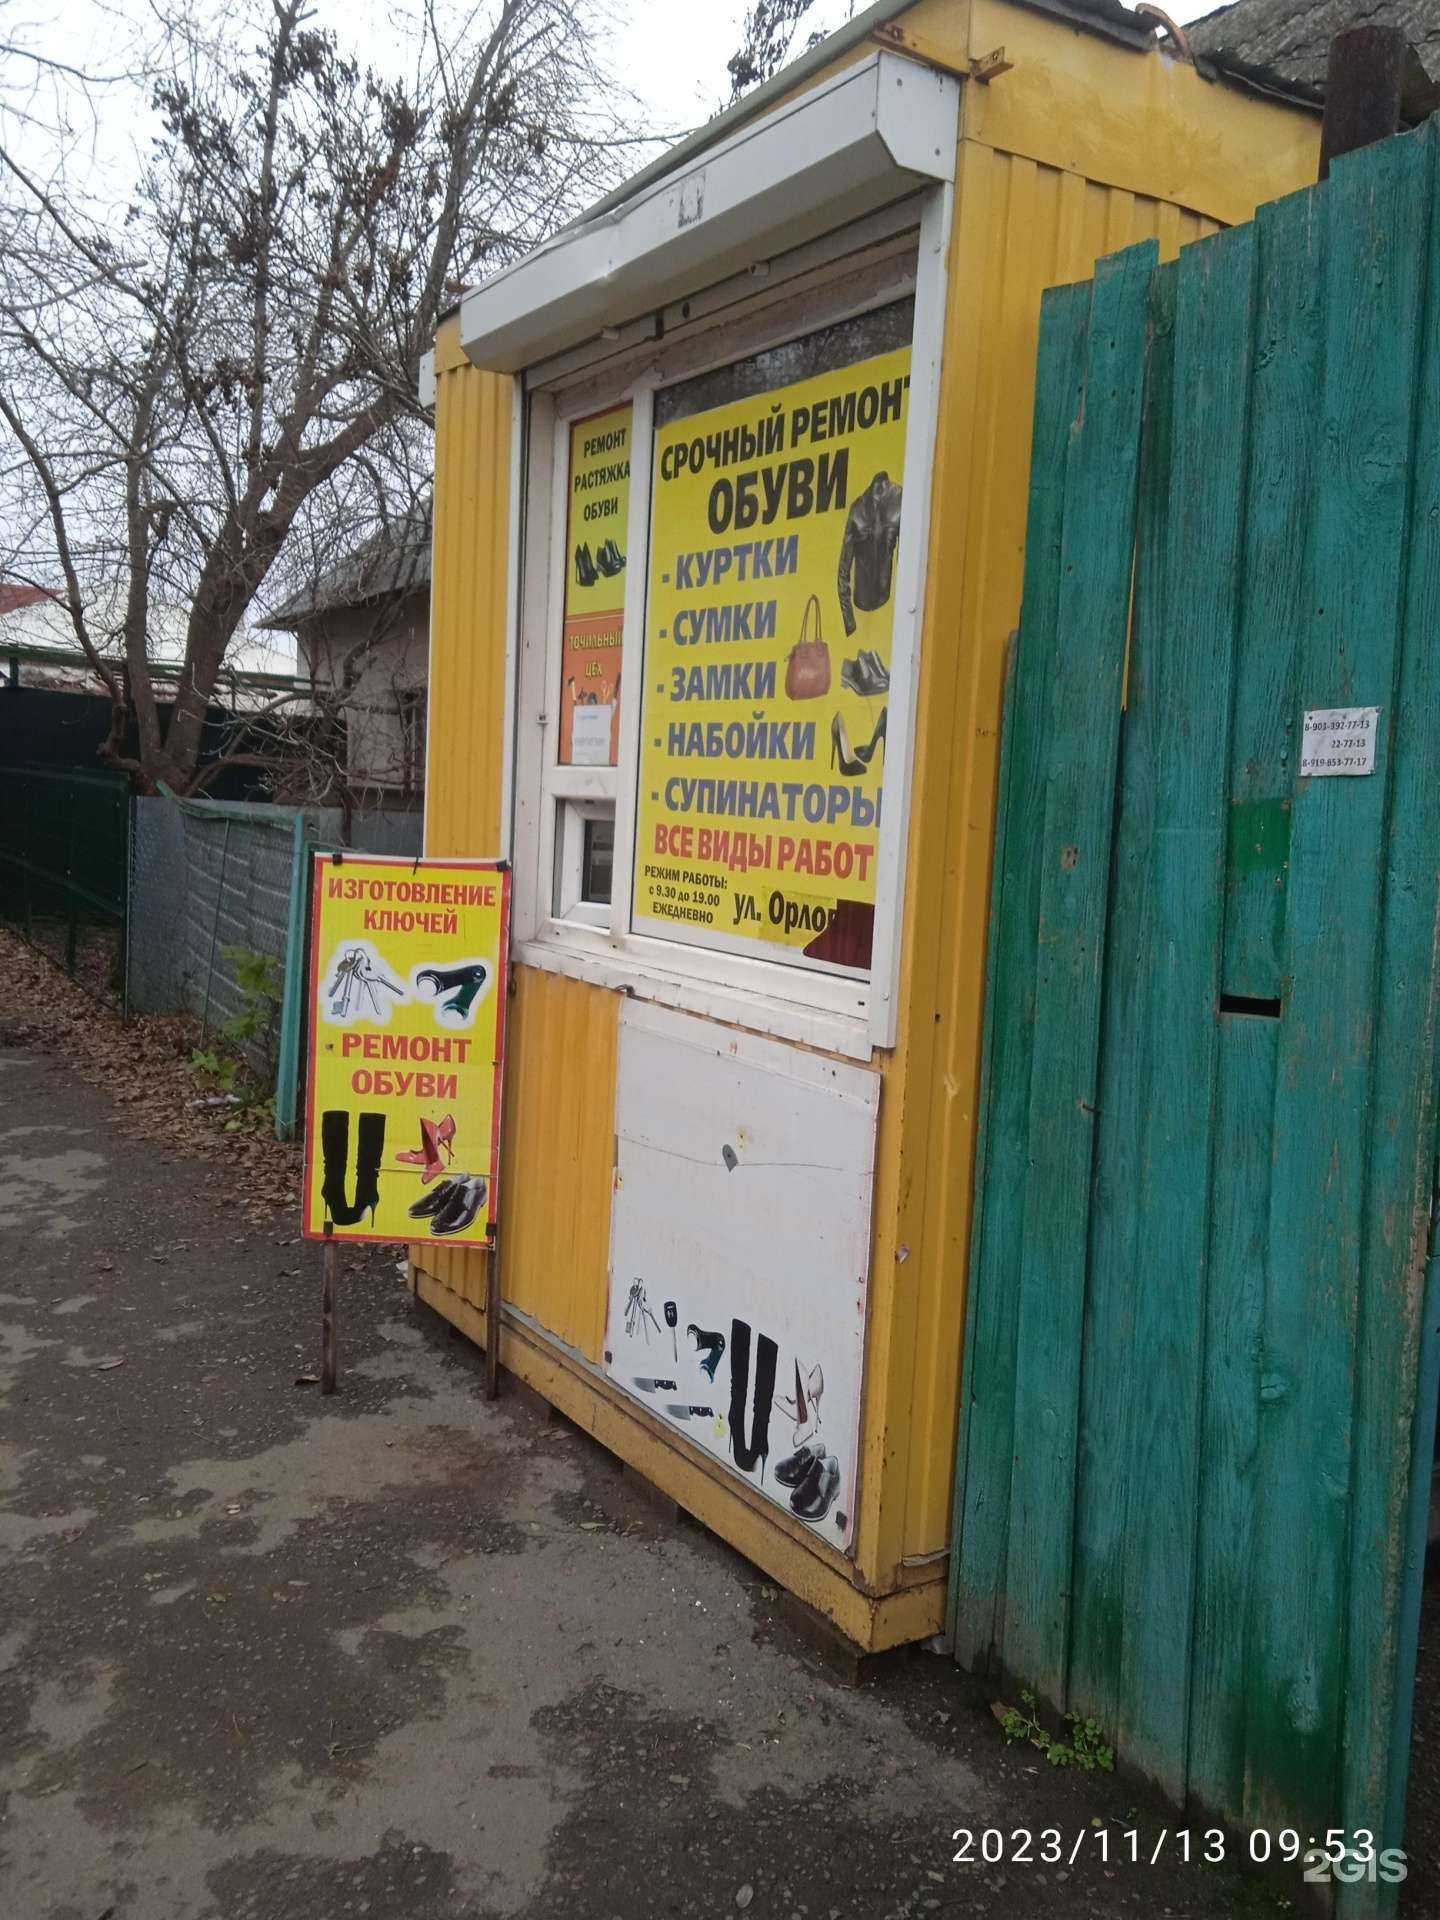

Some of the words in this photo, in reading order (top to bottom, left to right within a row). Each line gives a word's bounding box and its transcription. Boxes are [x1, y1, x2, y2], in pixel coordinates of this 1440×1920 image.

[584, 427, 627, 458] РЕМОНТ
[660, 404, 784, 481] СРОЧНЫЙ
[574, 460, 631, 493] РАСТЯЖКА
[708, 448, 850, 535] ОБУВИ
[583, 501, 619, 522] ОБУВИ
[675, 534, 799, 590] КУРТКИ
[673, 600, 777, 646] СУМКИ
[670, 662, 776, 701] ЗАМКИ
[667, 712, 817, 761] НАБОЙКИ
[664, 776, 883, 828] СУПИНАТОРЫ
[654, 823, 694, 859] ВСЕ
[699, 830, 771, 873] ВИДЫ
[777, 837, 875, 881] РАБОТ
[328, 877, 497, 908] ИЗГОТОВЛЕНИЕ
[644, 864, 681, 883] РЕЖИМ
[682, 870, 728, 890] РАБОТЫ:
[648, 887, 655, 896] с
[656, 884, 676, 900] 9.30
[677, 891, 690, 904] до
[692, 891, 720, 907] 19.00
[652, 900, 714, 924] ЕЖЕДНЕВНО
[733, 892, 762, 925] ул.
[362, 907, 458, 936] КЛЮЧЕЙ
[341, 1032, 473, 1064] РЕМОНТ
[351, 1068, 458, 1100] ОБУВИ
